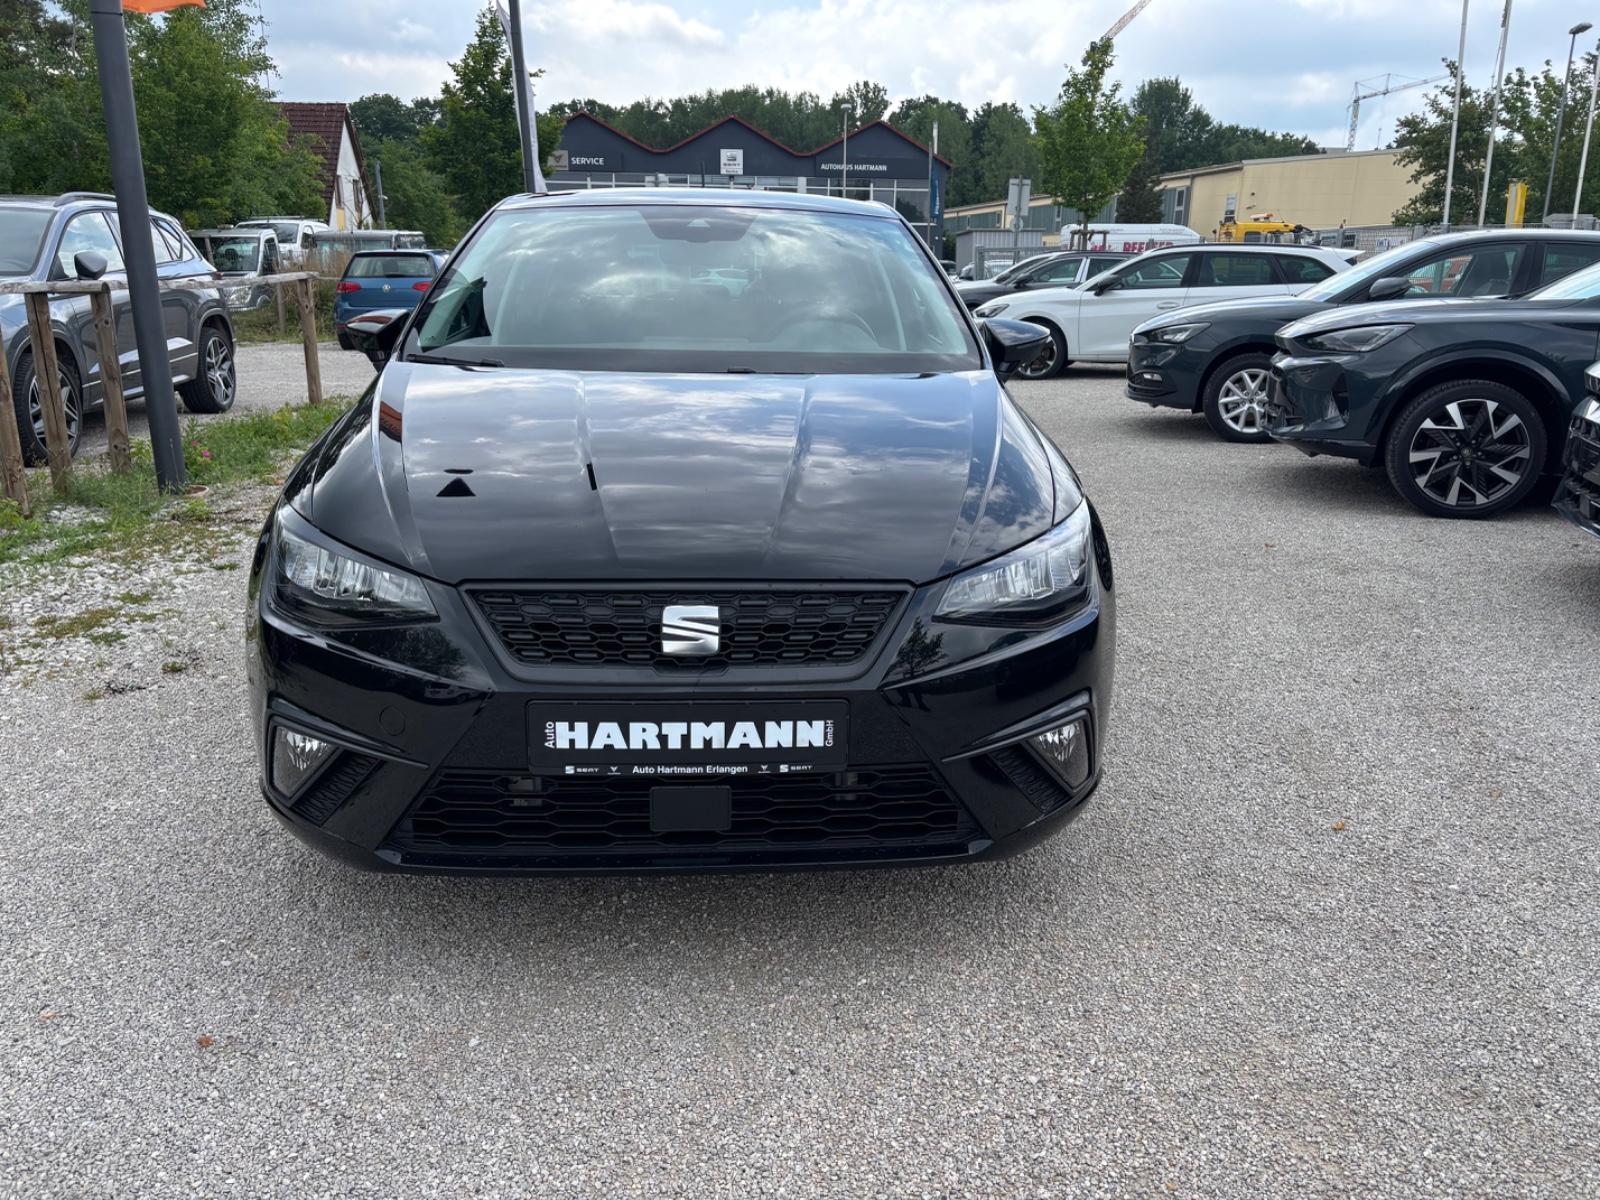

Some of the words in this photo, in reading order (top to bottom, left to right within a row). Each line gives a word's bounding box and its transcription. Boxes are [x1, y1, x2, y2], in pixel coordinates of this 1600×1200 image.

[571, 157, 604, 165] SERVICE
[820, 163, 853, 171] AUTOHAUS
[544, 721, 555, 748] Auto
[556, 720, 825, 749] HARTMANN
[825, 720, 834, 746] GmbH
[632, 765, 655, 774] Auto
[657, 765, 703, 774] Hartmann
[706, 764, 748, 774] Erlangen
